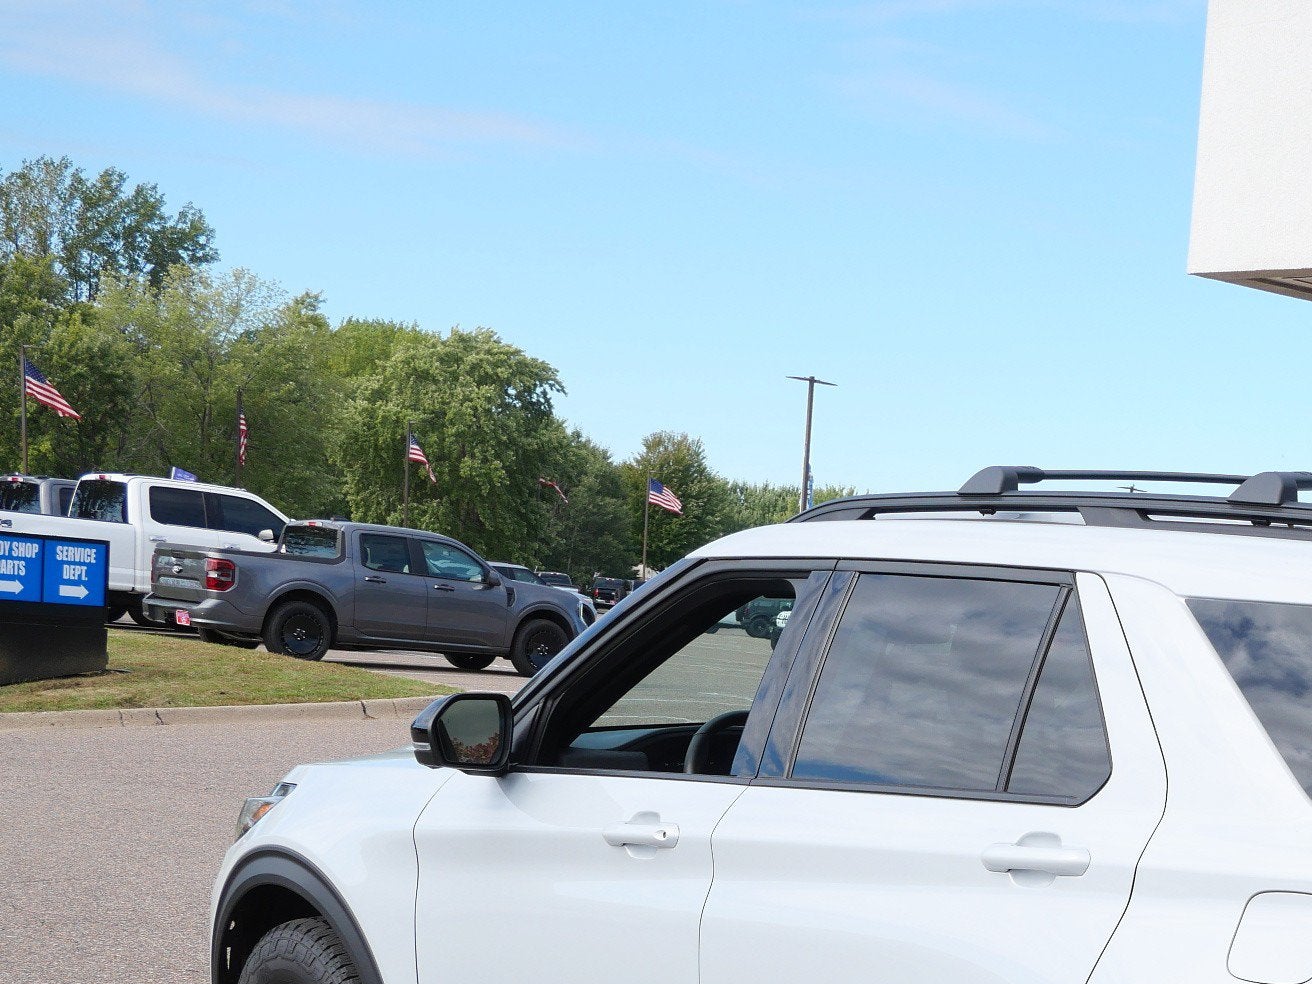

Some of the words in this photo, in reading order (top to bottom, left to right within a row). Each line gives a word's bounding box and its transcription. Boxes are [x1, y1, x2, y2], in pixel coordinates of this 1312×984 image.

[12, 541, 39, 559] SHOP
[56, 545, 97, 564] SERVICE
[0, 559, 26, 576] ARTS
[62, 564, 88, 581] DEPT.
